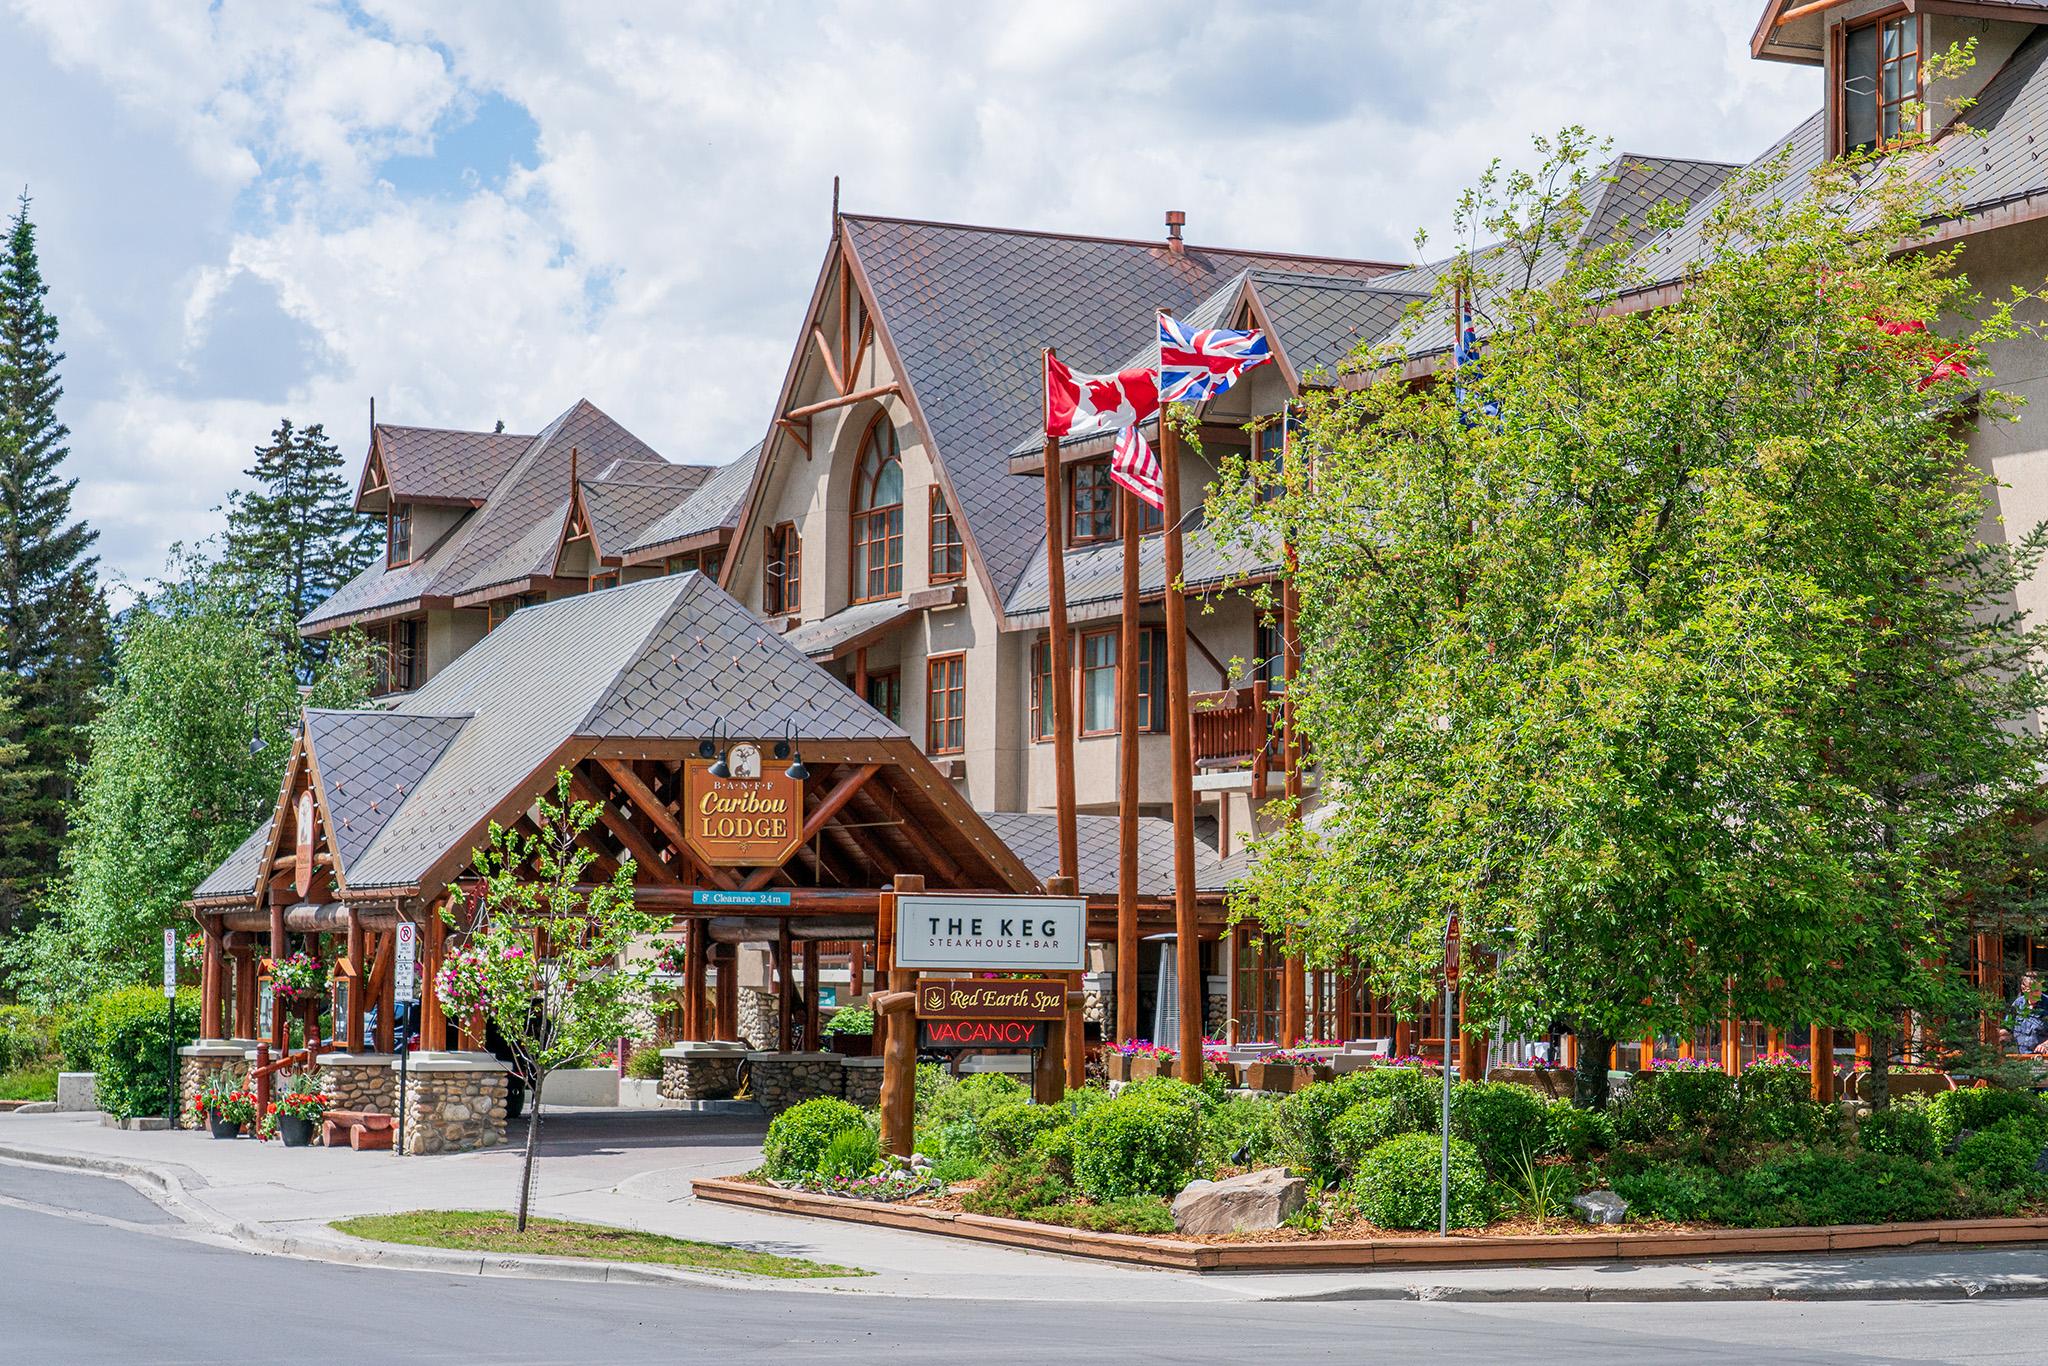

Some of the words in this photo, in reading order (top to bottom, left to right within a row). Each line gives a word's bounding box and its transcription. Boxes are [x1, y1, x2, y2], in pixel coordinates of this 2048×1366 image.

[699, 790, 788, 816] Caribou
[701, 817, 787, 838] LODGE
[713, 894, 756, 903] Clearance
[929, 918, 982, 936] THE
[1000, 919, 1056, 937] KEG
[929, 939, 1021, 948] STEAKHOUSE
[1034, 940, 1059, 949] BAR
[1446, 940, 1460, 968] STOP
[950, 988, 983, 1009] Red
[982, 989, 1029, 1007] Earth
[1031, 991, 1060, 1012] Spa
[927, 1022, 1035, 1042] VACANCY
